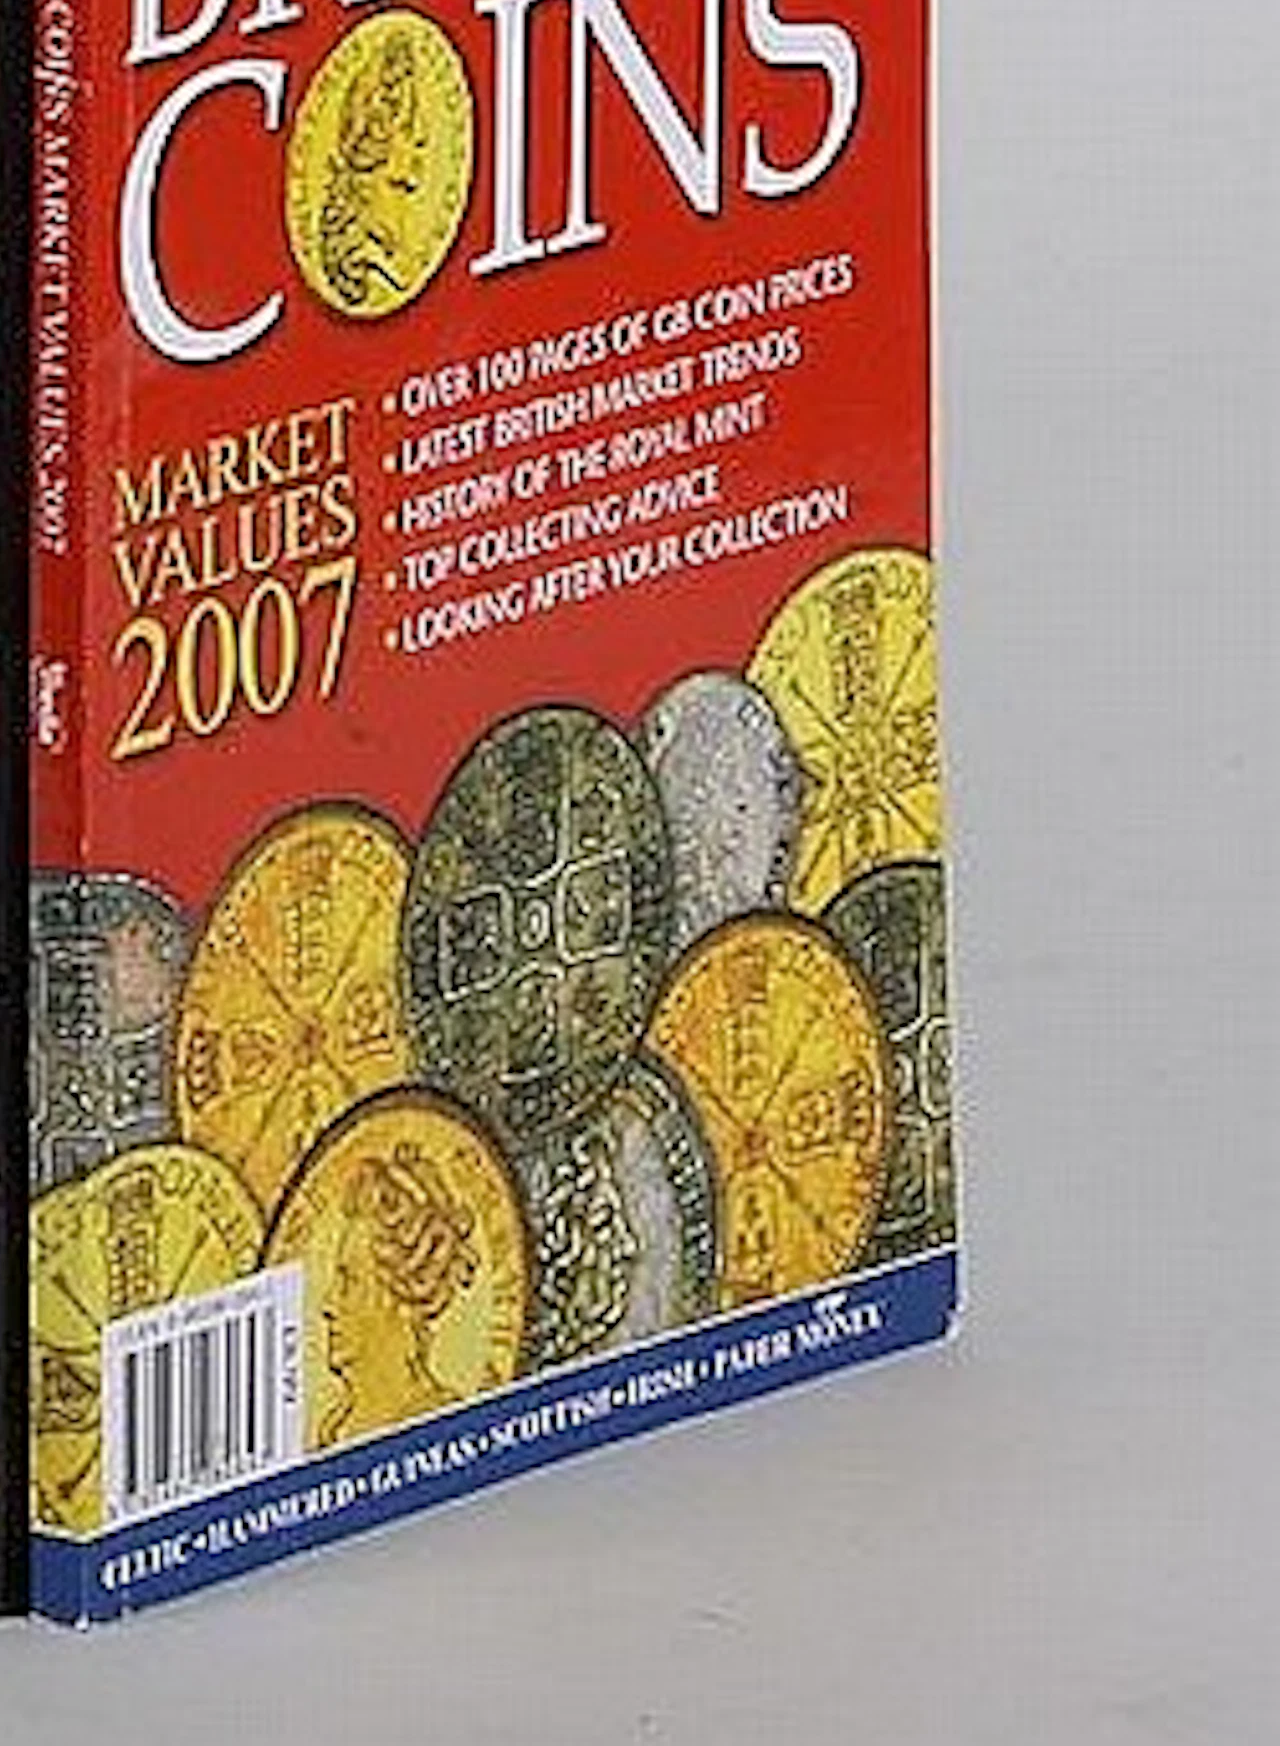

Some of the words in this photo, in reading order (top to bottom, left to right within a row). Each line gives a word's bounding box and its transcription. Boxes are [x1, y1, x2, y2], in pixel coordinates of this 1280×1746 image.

[402, 365, 472, 418] OVER
[478, 355, 526, 395] 100
[527, 322, 608, 377] PAGES
[612, 312, 648, 356] OF
[693, 278, 766, 329] COIN
[768, 254, 854, 310] PRICES
[402, 415, 490, 475] LATEST
[493, 386, 592, 448] BRITISH
[592, 357, 697, 419] MARKET
[699, 326, 802, 386] TRENDS
[115, 397, 357, 534] MARKET
[402, 480, 512, 536] HISTORY
[514, 454, 551, 499] OF
[556, 438, 607, 488] THE
[608, 418, 692, 474] ROYAL
[693, 391, 767, 444] MINT
[402, 545, 458, 592] TOP
[459, 494, 623, 577] COLLECTING
[625, 464, 722, 521] ADVICE
[114, 474, 357, 608] VALUES
[402, 582, 526, 654] LOOKING
[529, 553, 606, 613] AFTER
[607, 535, 684, 588] YOUR
[685, 485, 848, 565] COLLECTION
[111, 556, 357, 761] 2007
